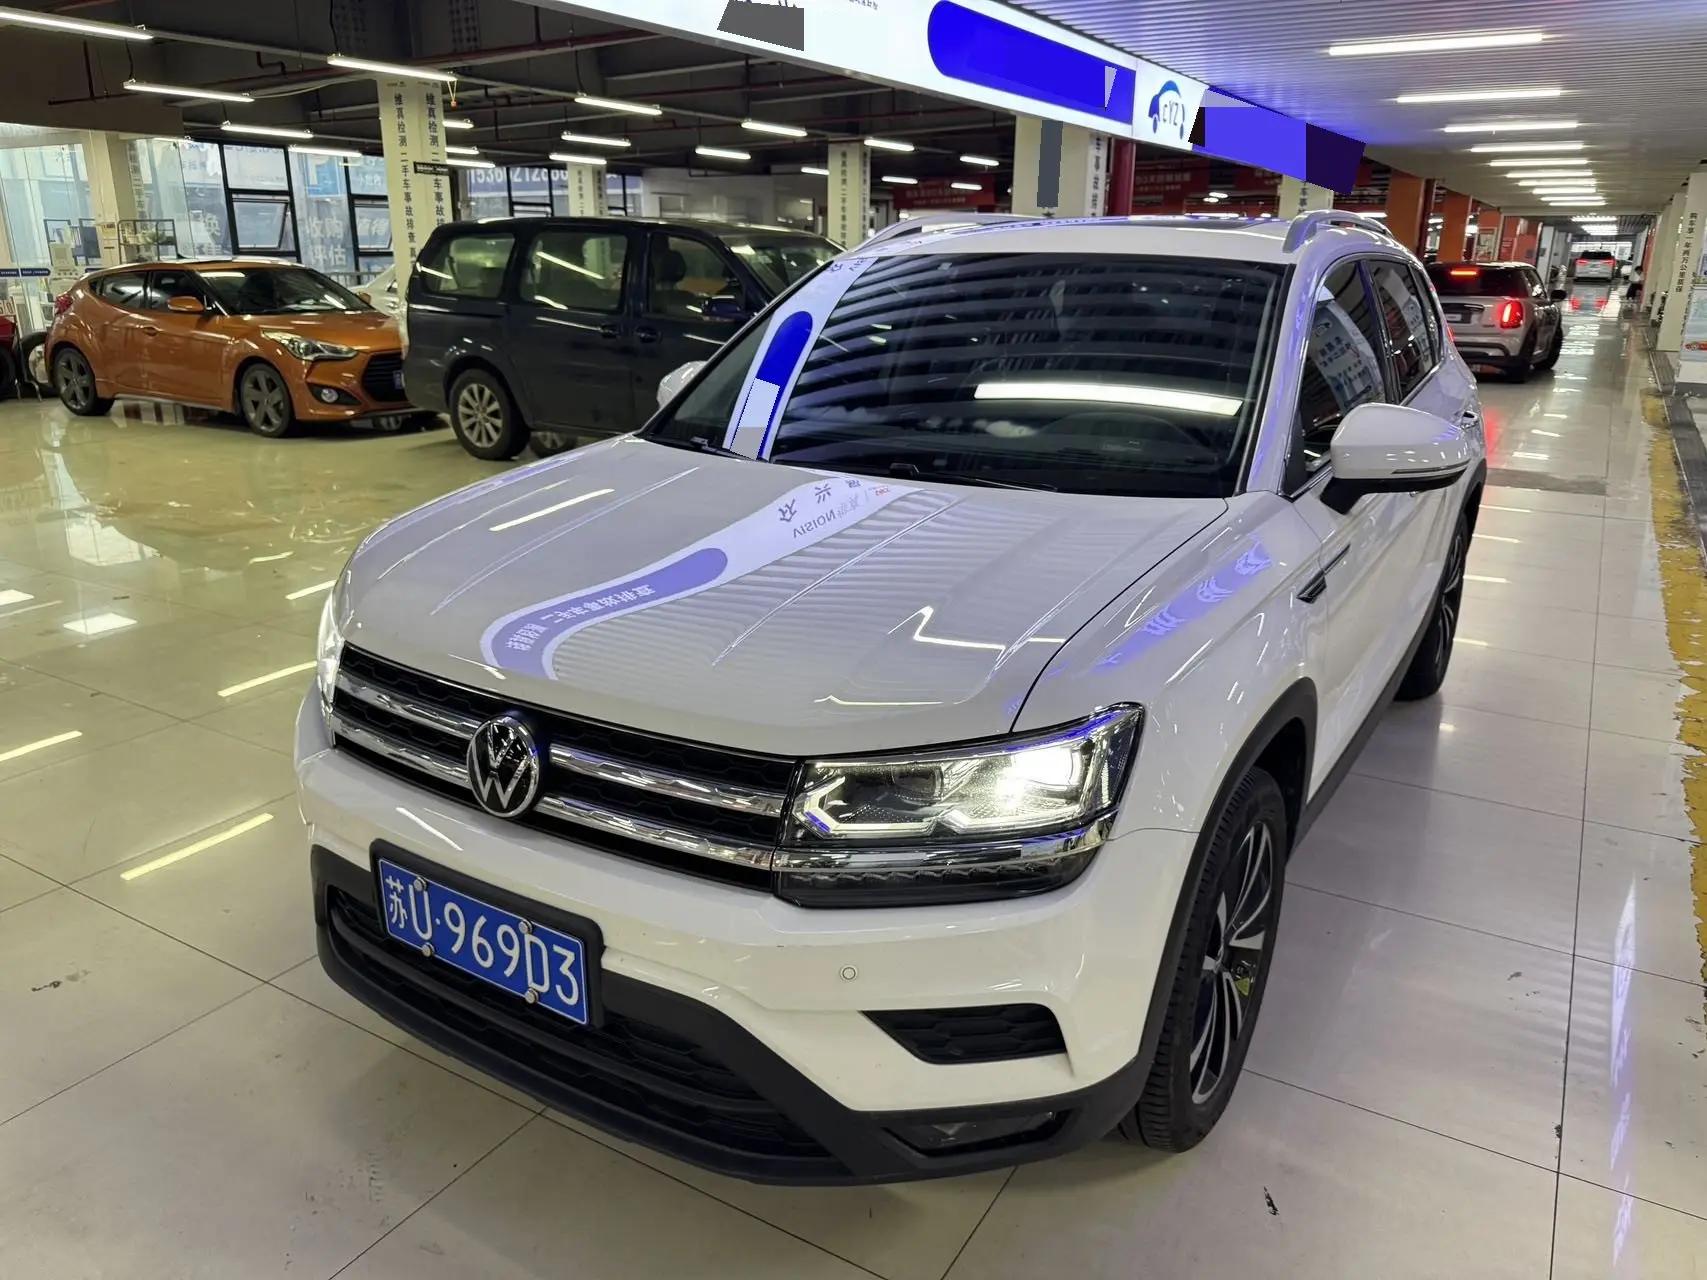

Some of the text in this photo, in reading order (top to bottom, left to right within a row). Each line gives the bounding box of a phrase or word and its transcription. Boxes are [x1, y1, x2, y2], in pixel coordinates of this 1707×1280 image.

[394, 92, 417, 266] 维真检测二手车事故排查真
